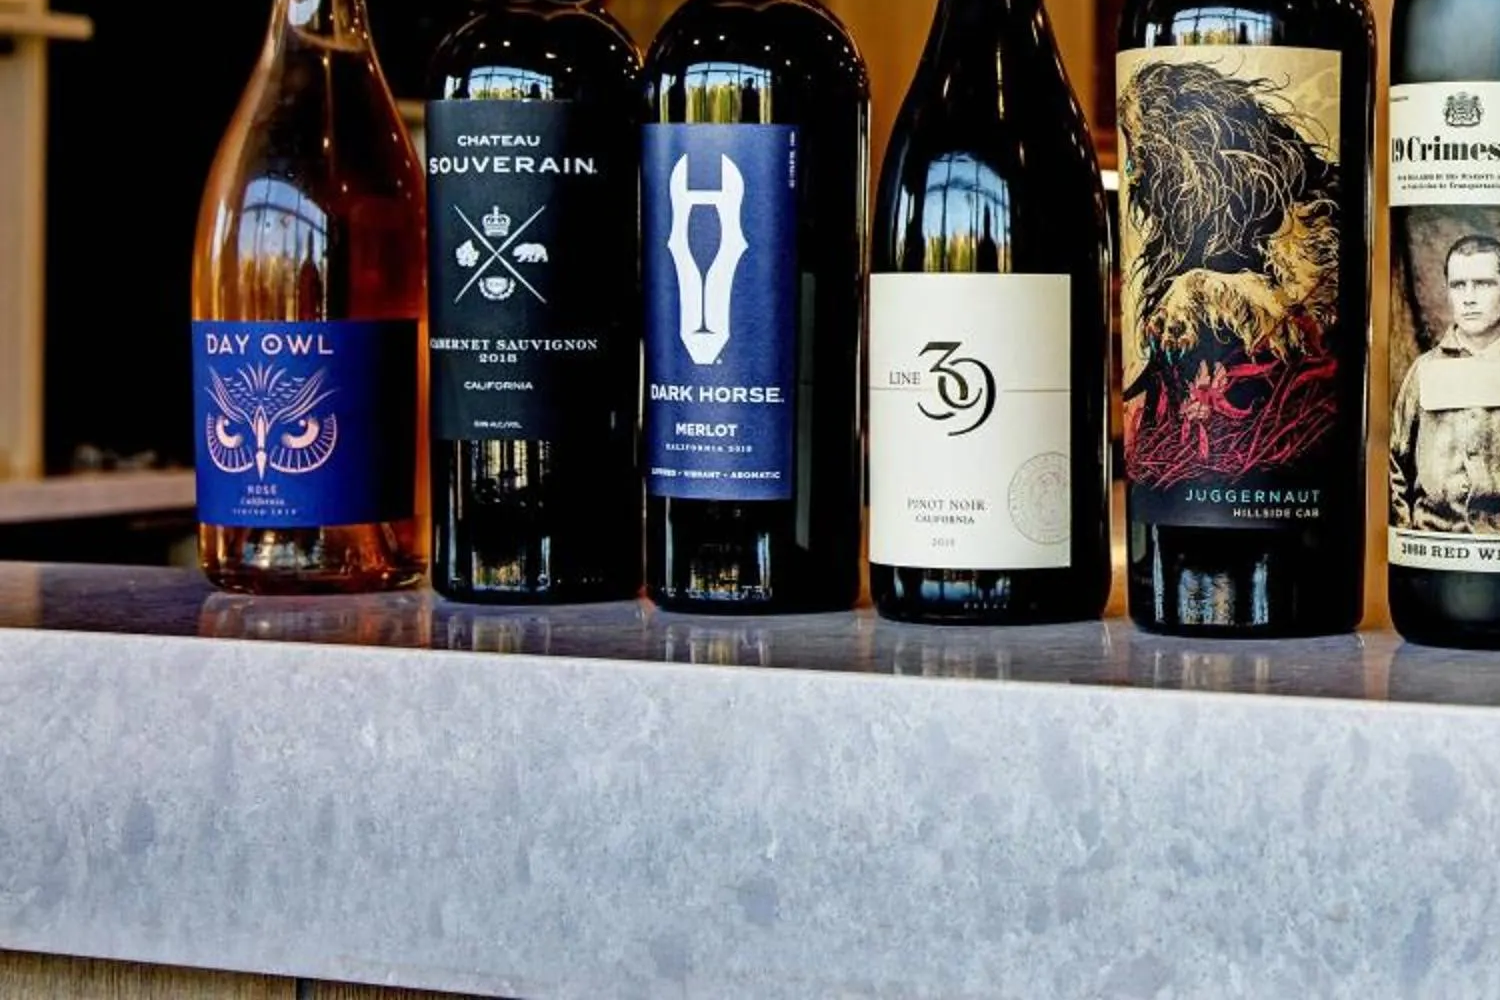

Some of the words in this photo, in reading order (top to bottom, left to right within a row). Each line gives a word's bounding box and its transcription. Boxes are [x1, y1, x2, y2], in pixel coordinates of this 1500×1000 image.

[457, 135, 541, 147] CHATEAU
[206, 333, 250, 355] DAY
[260, 333, 334, 356] OWL
[495, 338, 599, 351] SAUVIGNON
[464, 381, 534, 391] CALIFORNIA
[888, 371, 921, 386] LINE
[917, 341, 997, 437] 39
[650, 383, 694, 403] DARK
[675, 422, 739, 438] MERLOT
[730, 470, 781, 479] AROMATIC
[1185, 489, 1321, 504] JUGGERNAUT
[907, 498, 944, 511] PINOT
[915, 514, 976, 525] CALIFORNIA
[1232, 507, 1292, 518] HILLSIDE
[1295, 507, 1320, 519] CAB
[1430, 544, 1471, 560] RED
